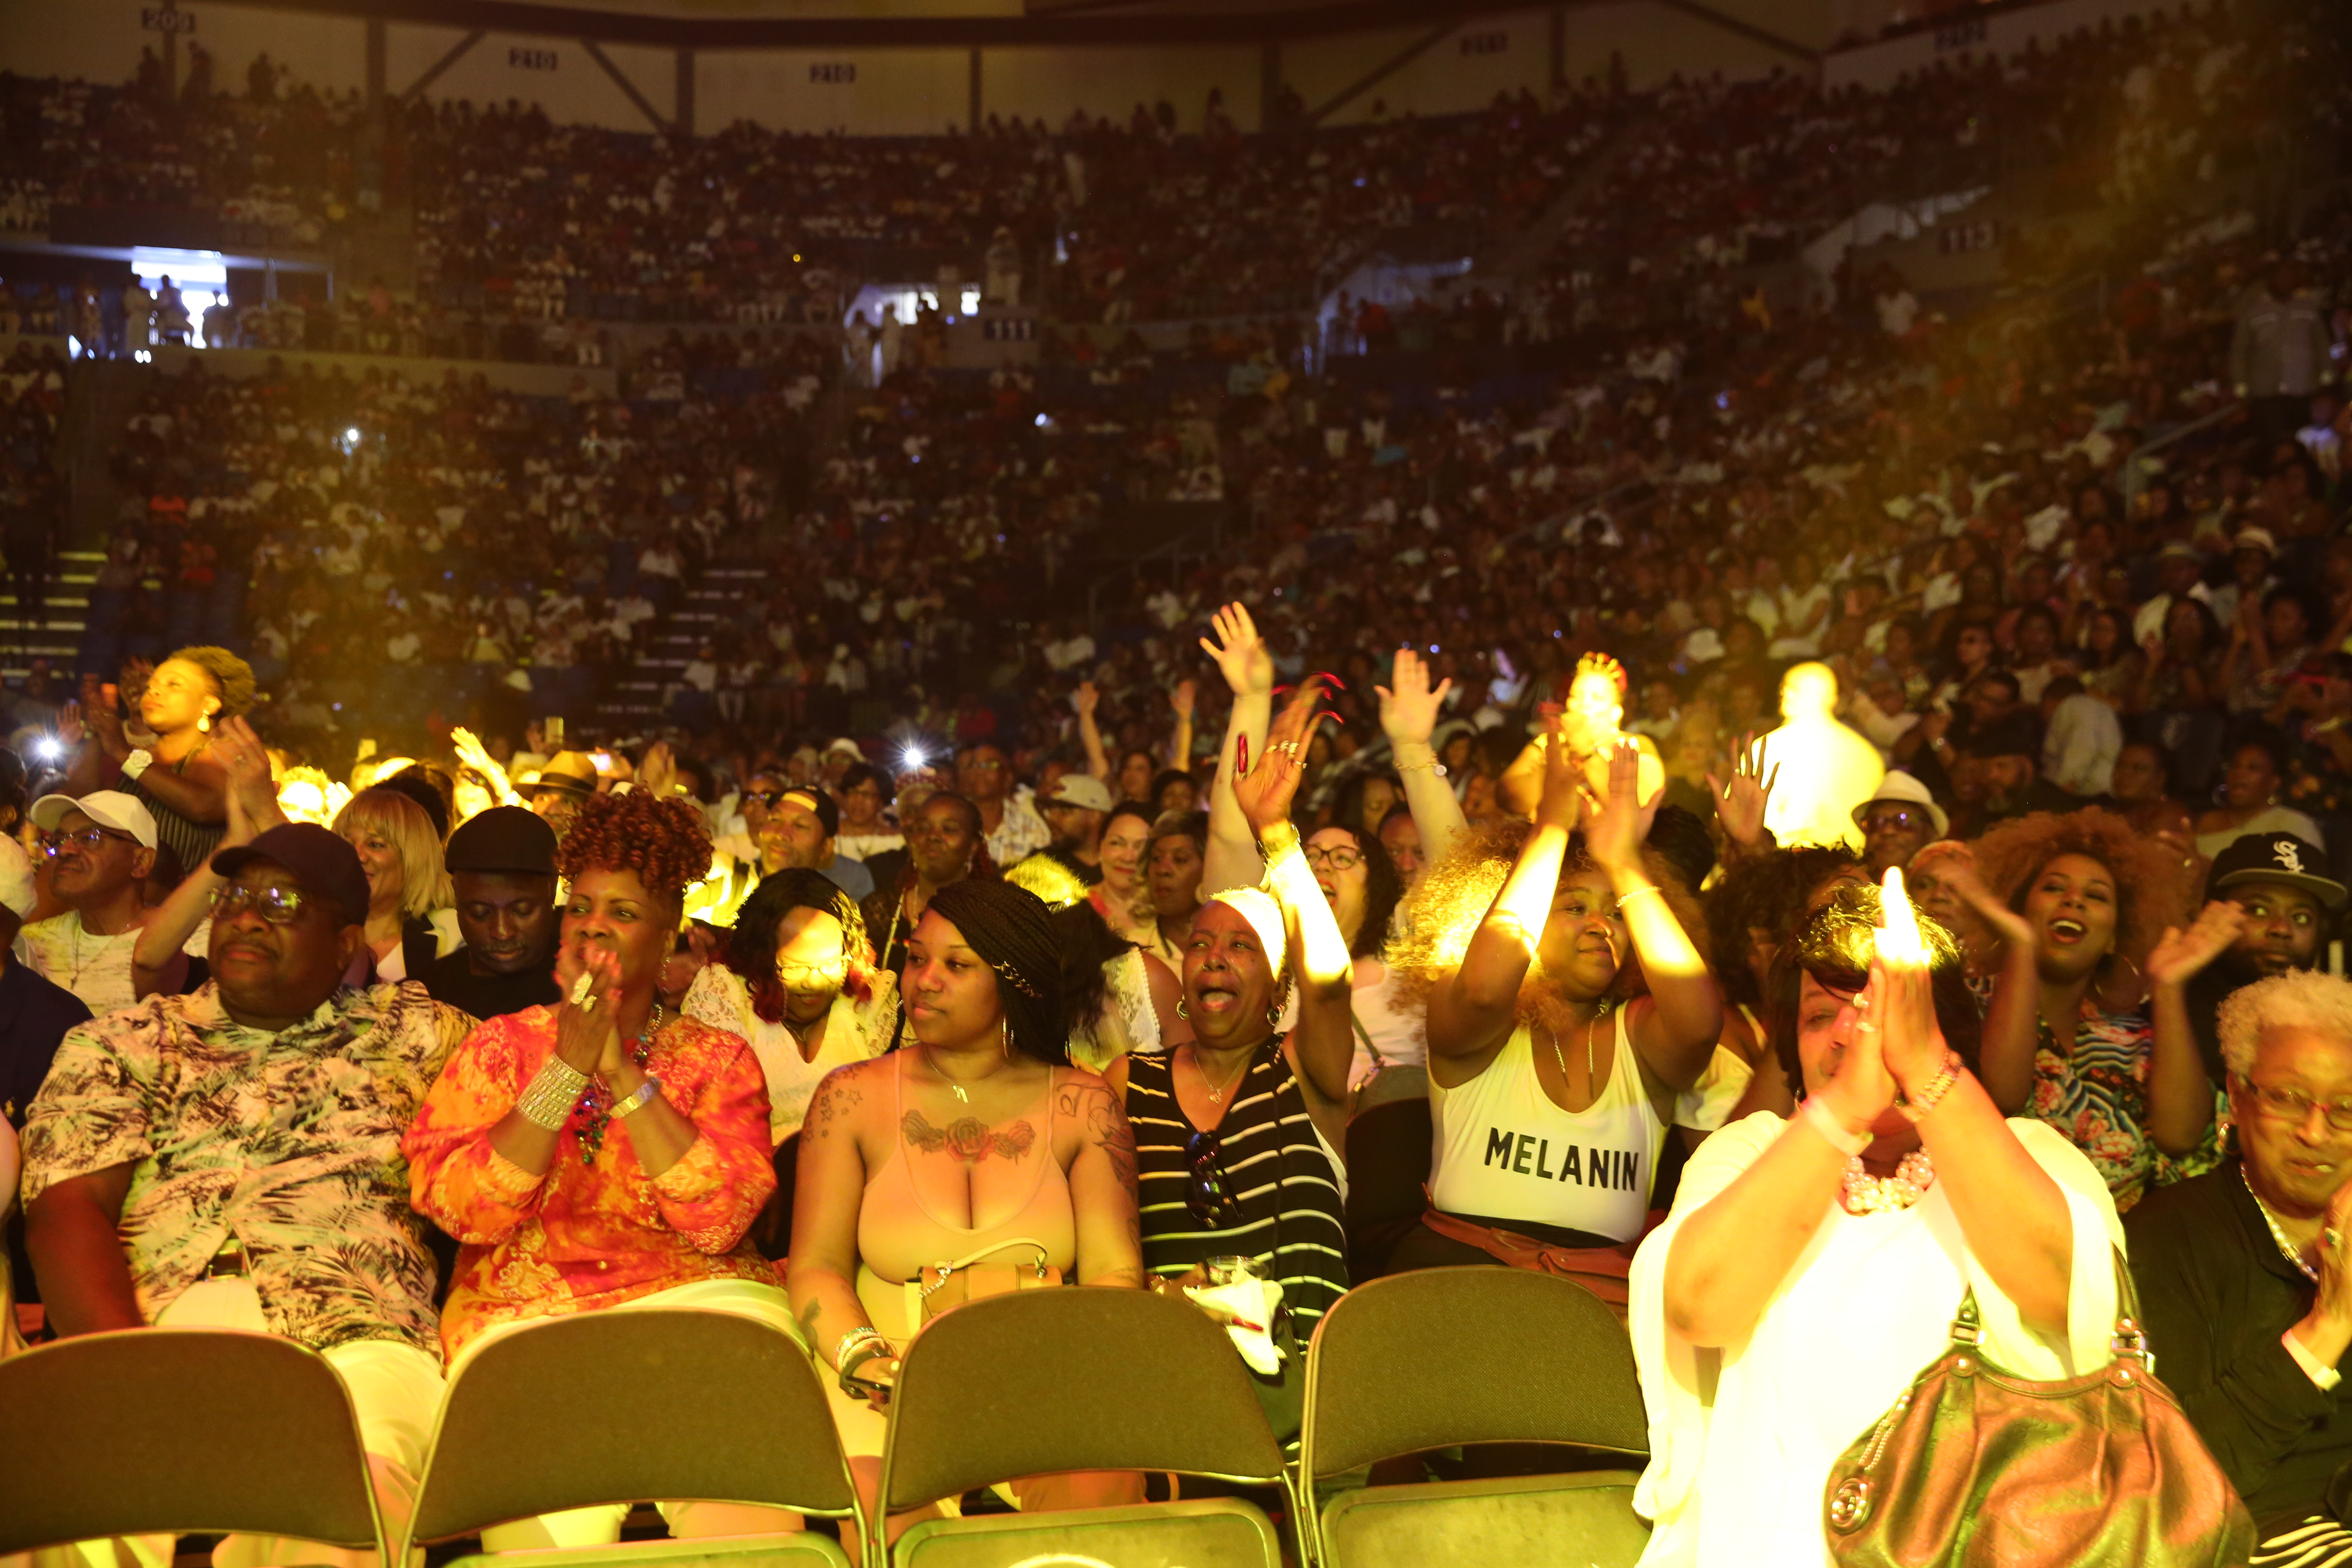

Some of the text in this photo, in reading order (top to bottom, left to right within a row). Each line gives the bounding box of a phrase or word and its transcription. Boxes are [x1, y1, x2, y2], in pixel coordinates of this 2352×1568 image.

[1949, 223, 1994, 250] 113
[993, 320, 1031, 340] 111
[1484, 1127, 1638, 1191] MELANIN
